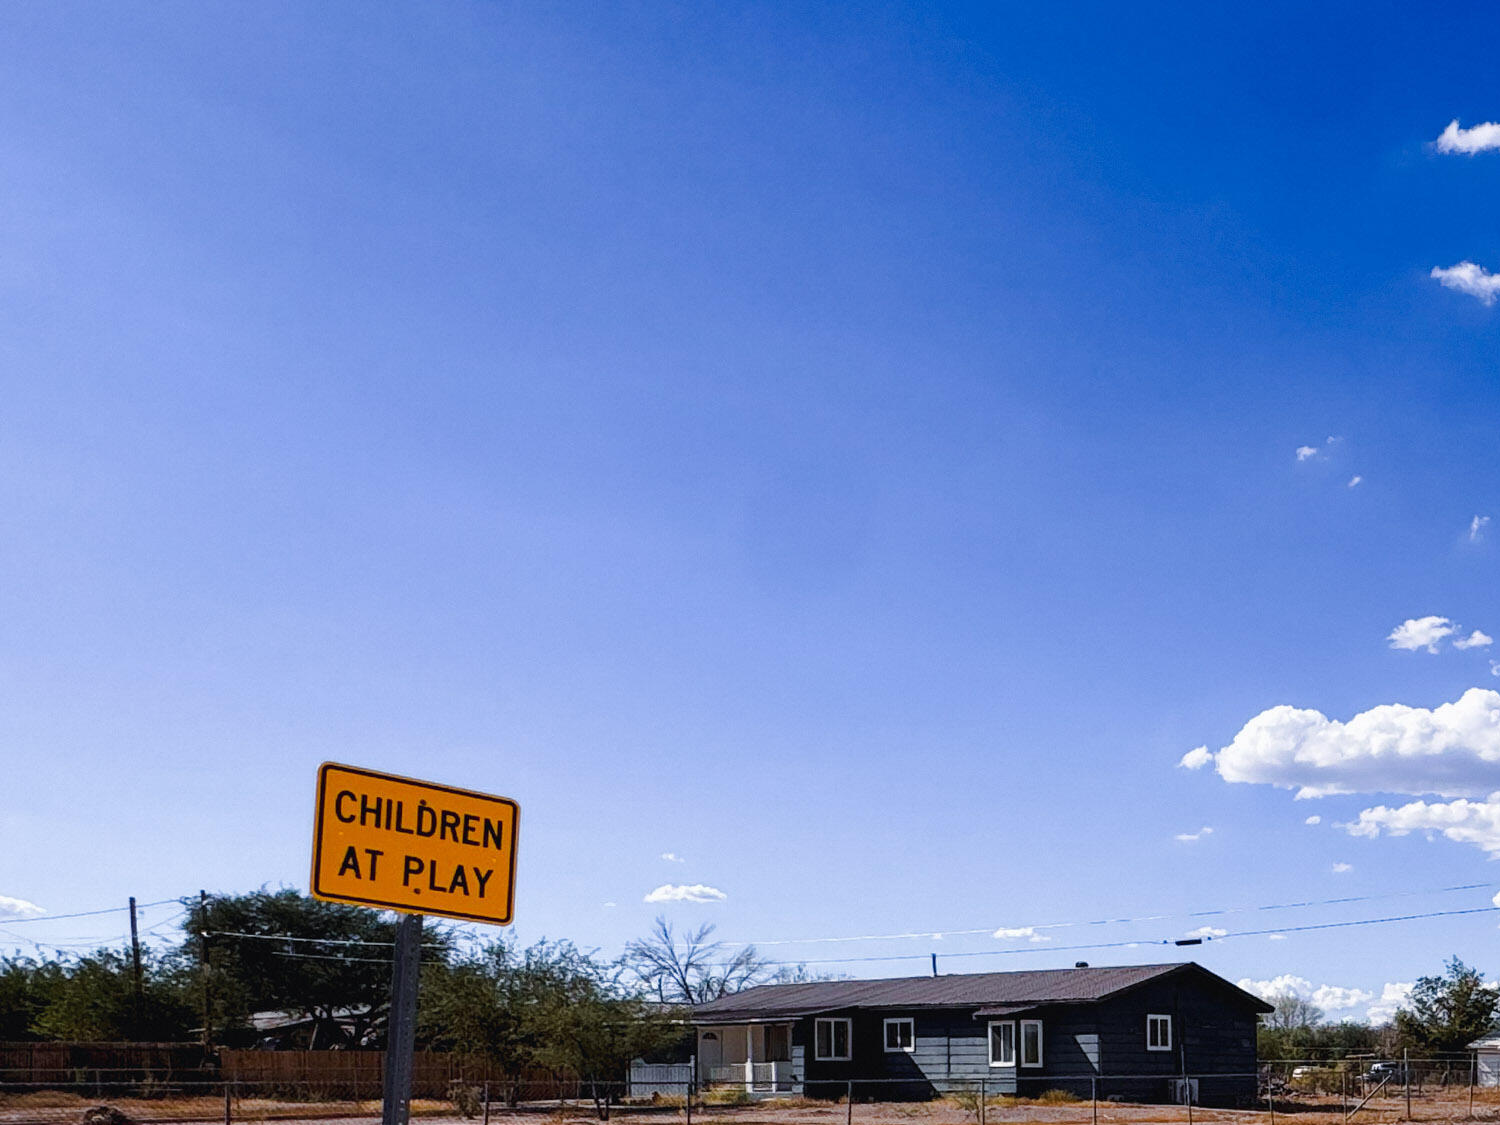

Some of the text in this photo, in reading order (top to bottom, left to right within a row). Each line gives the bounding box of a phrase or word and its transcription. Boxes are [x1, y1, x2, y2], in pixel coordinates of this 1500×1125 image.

[335, 790, 503, 850] CHILDREN
[338, 846, 494, 898] AT PLAY
